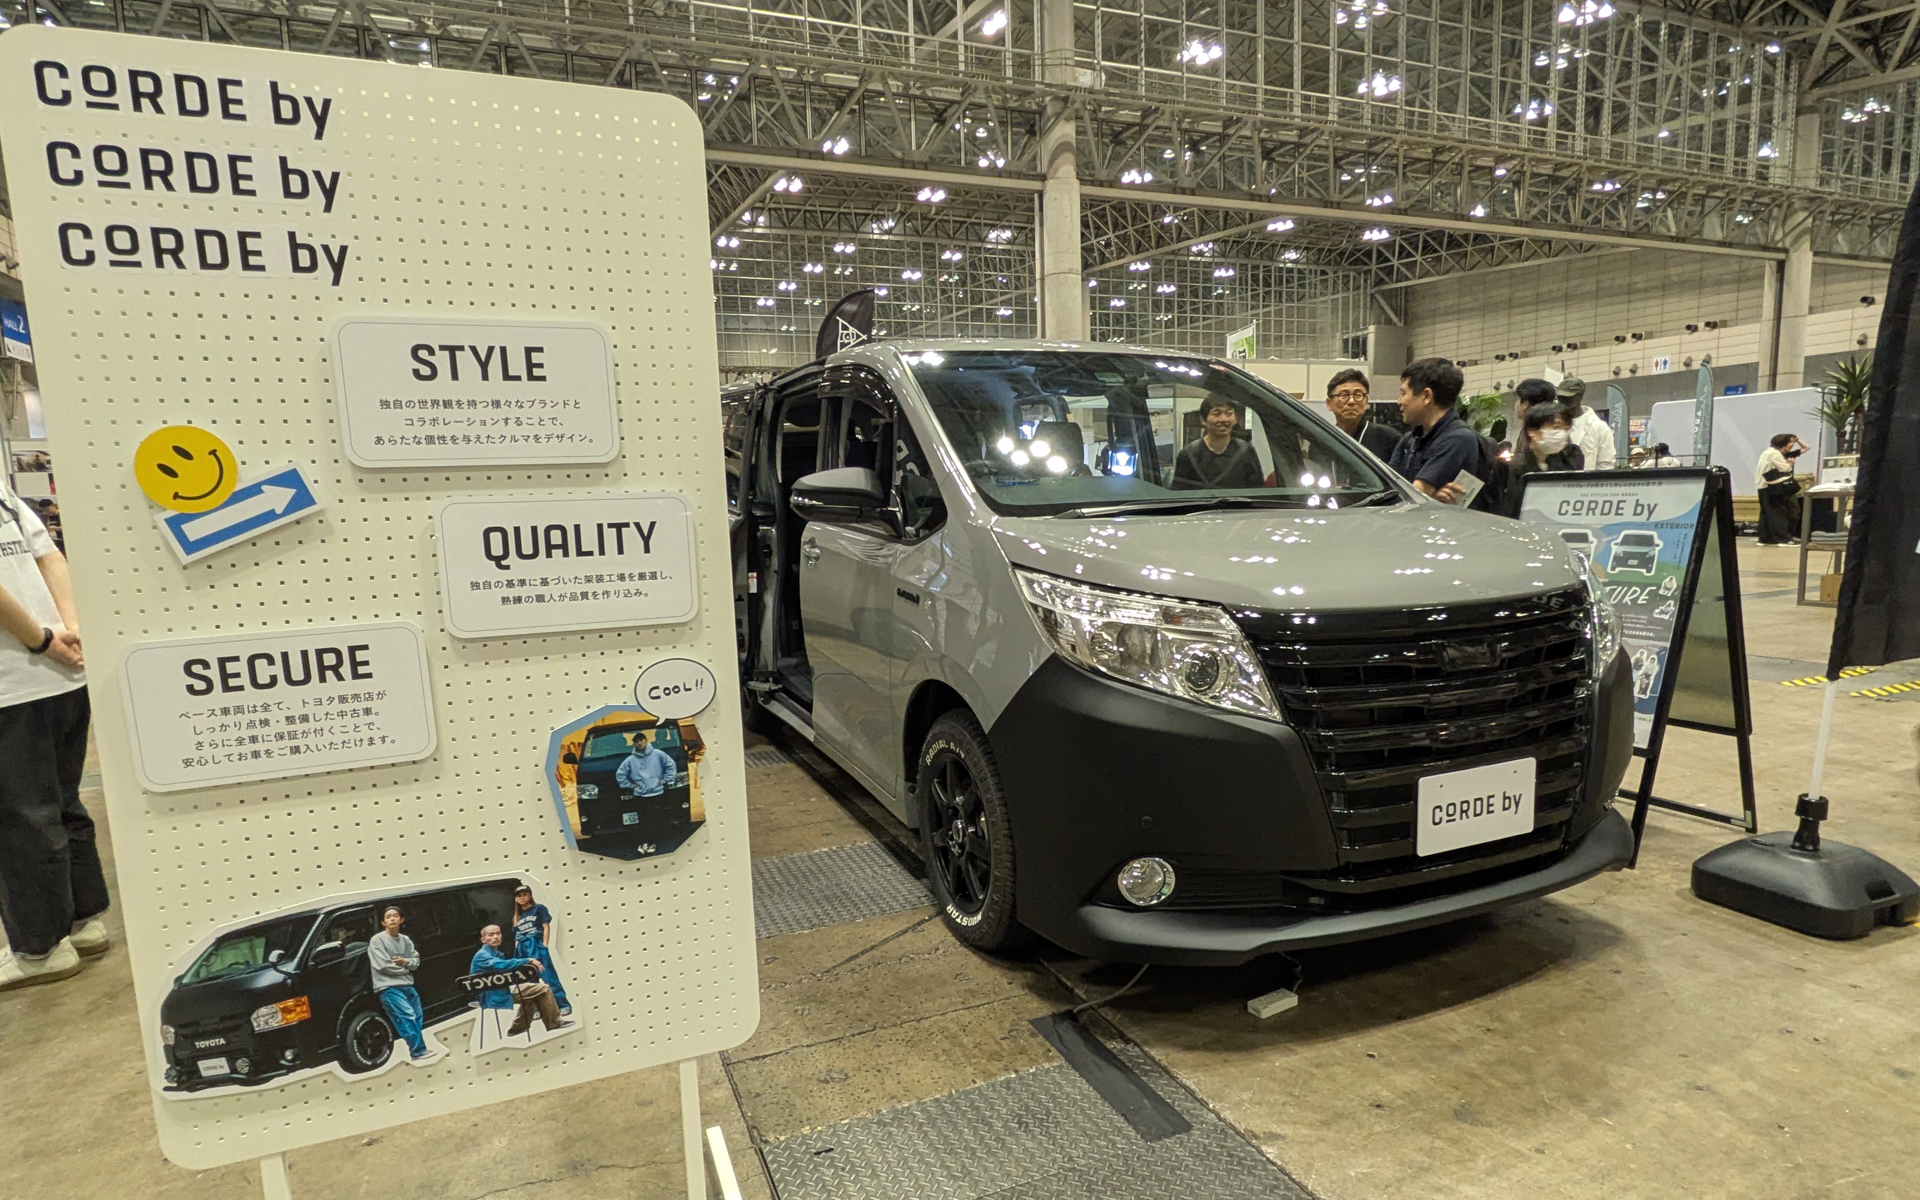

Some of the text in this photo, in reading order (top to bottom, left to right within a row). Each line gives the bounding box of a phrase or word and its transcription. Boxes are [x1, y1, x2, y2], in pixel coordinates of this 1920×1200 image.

[34, 60, 332, 140] CORDE by
[46, 141, 341, 213] CORDE by
[58, 222, 348, 287] CORDE by
[17, 314, 26, 334] 2
[410, 343, 547, 382] STYLE
[378, 398, 581, 410] 独自の世界観を持つ様々なブランドと
[404, 415, 564, 427] コラボレーションすることで、
[374, 433, 595, 446] あらたな個性を与えたクルマをデザイン。
[1557, 499, 1658, 521] CORDE by
[1654, 522, 1695, 530] EXTERIOR
[482, 520, 657, 571] QUALITY
[470, 570, 673, 591] 独自の基準に基づいた架装工場を厳選し、
[500, 588, 649, 606] 熟練の職人が品質を作り込み。
[182, 643, 374, 697] SECURE
[178, 690, 387, 720] ベース車両は全て、トヨタ販売店が
[193, 706, 380, 736] しっかり点検・整備した中古車。
[194, 721, 382, 751] さらに全車に保証が付くことで、
[182, 734, 396, 769] 安心してお車をご購入いただけます。
[925, 739, 949, 766] RADIAL
[1432, 790, 1522, 826] CORDE by
[946, 903, 982, 926] MUDSTAR
[194, 1037, 227, 1049] TOYOTA
